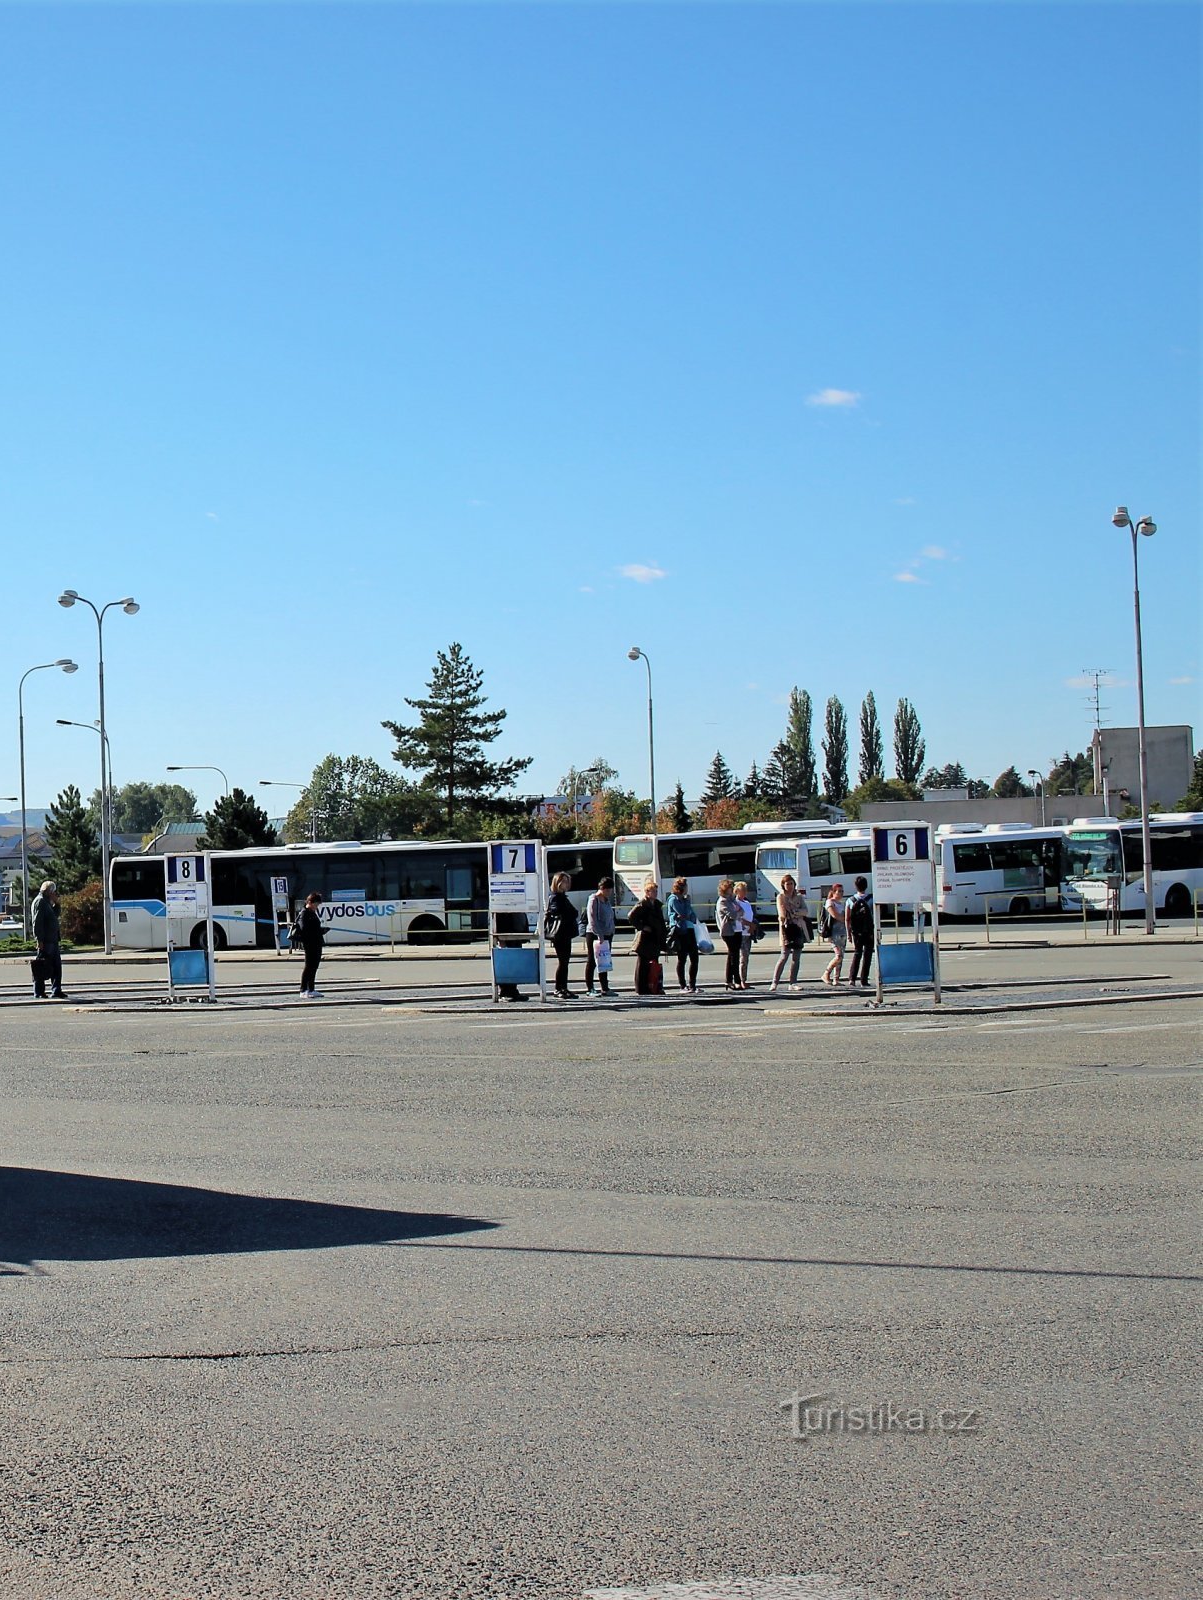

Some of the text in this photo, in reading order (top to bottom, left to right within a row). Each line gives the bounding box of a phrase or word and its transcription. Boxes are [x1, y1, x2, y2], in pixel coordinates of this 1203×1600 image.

[895, 833, 908, 856] 6
[508, 848, 519, 869] 7
[181, 860, 191, 879] 8
[317, 902, 396, 922] vydosbus
